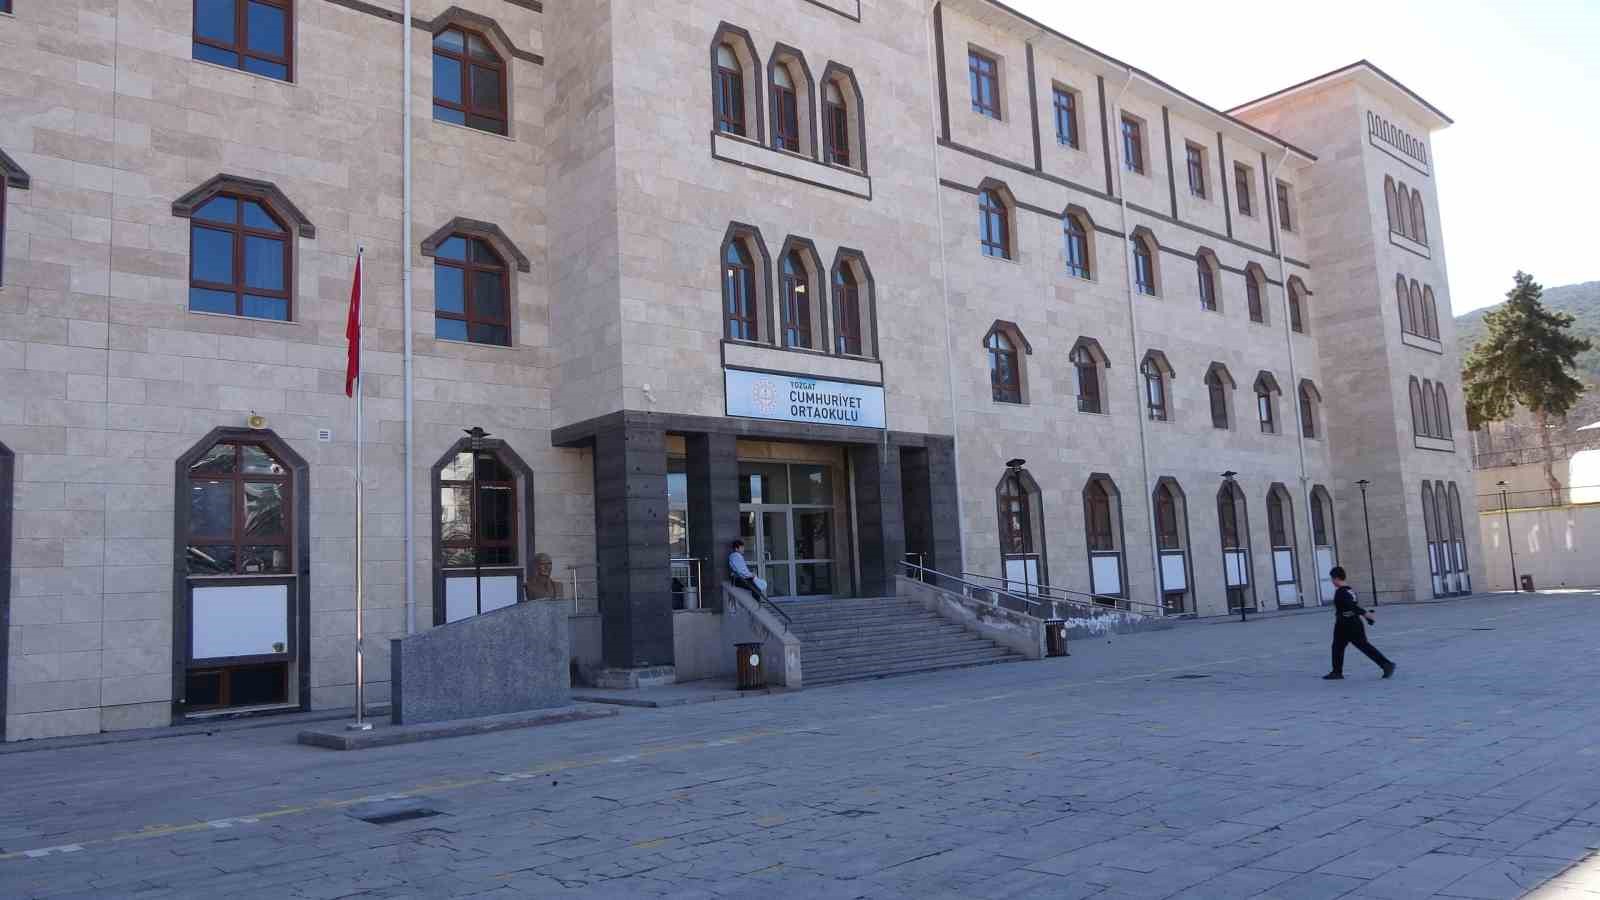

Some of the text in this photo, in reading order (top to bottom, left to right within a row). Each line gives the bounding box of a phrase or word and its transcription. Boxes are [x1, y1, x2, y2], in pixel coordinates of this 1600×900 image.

[791, 381, 815, 390] YOZGAT
[790, 391, 861, 408] CUMHURİYET
[791, 405, 857, 421] ORTAOKULU
